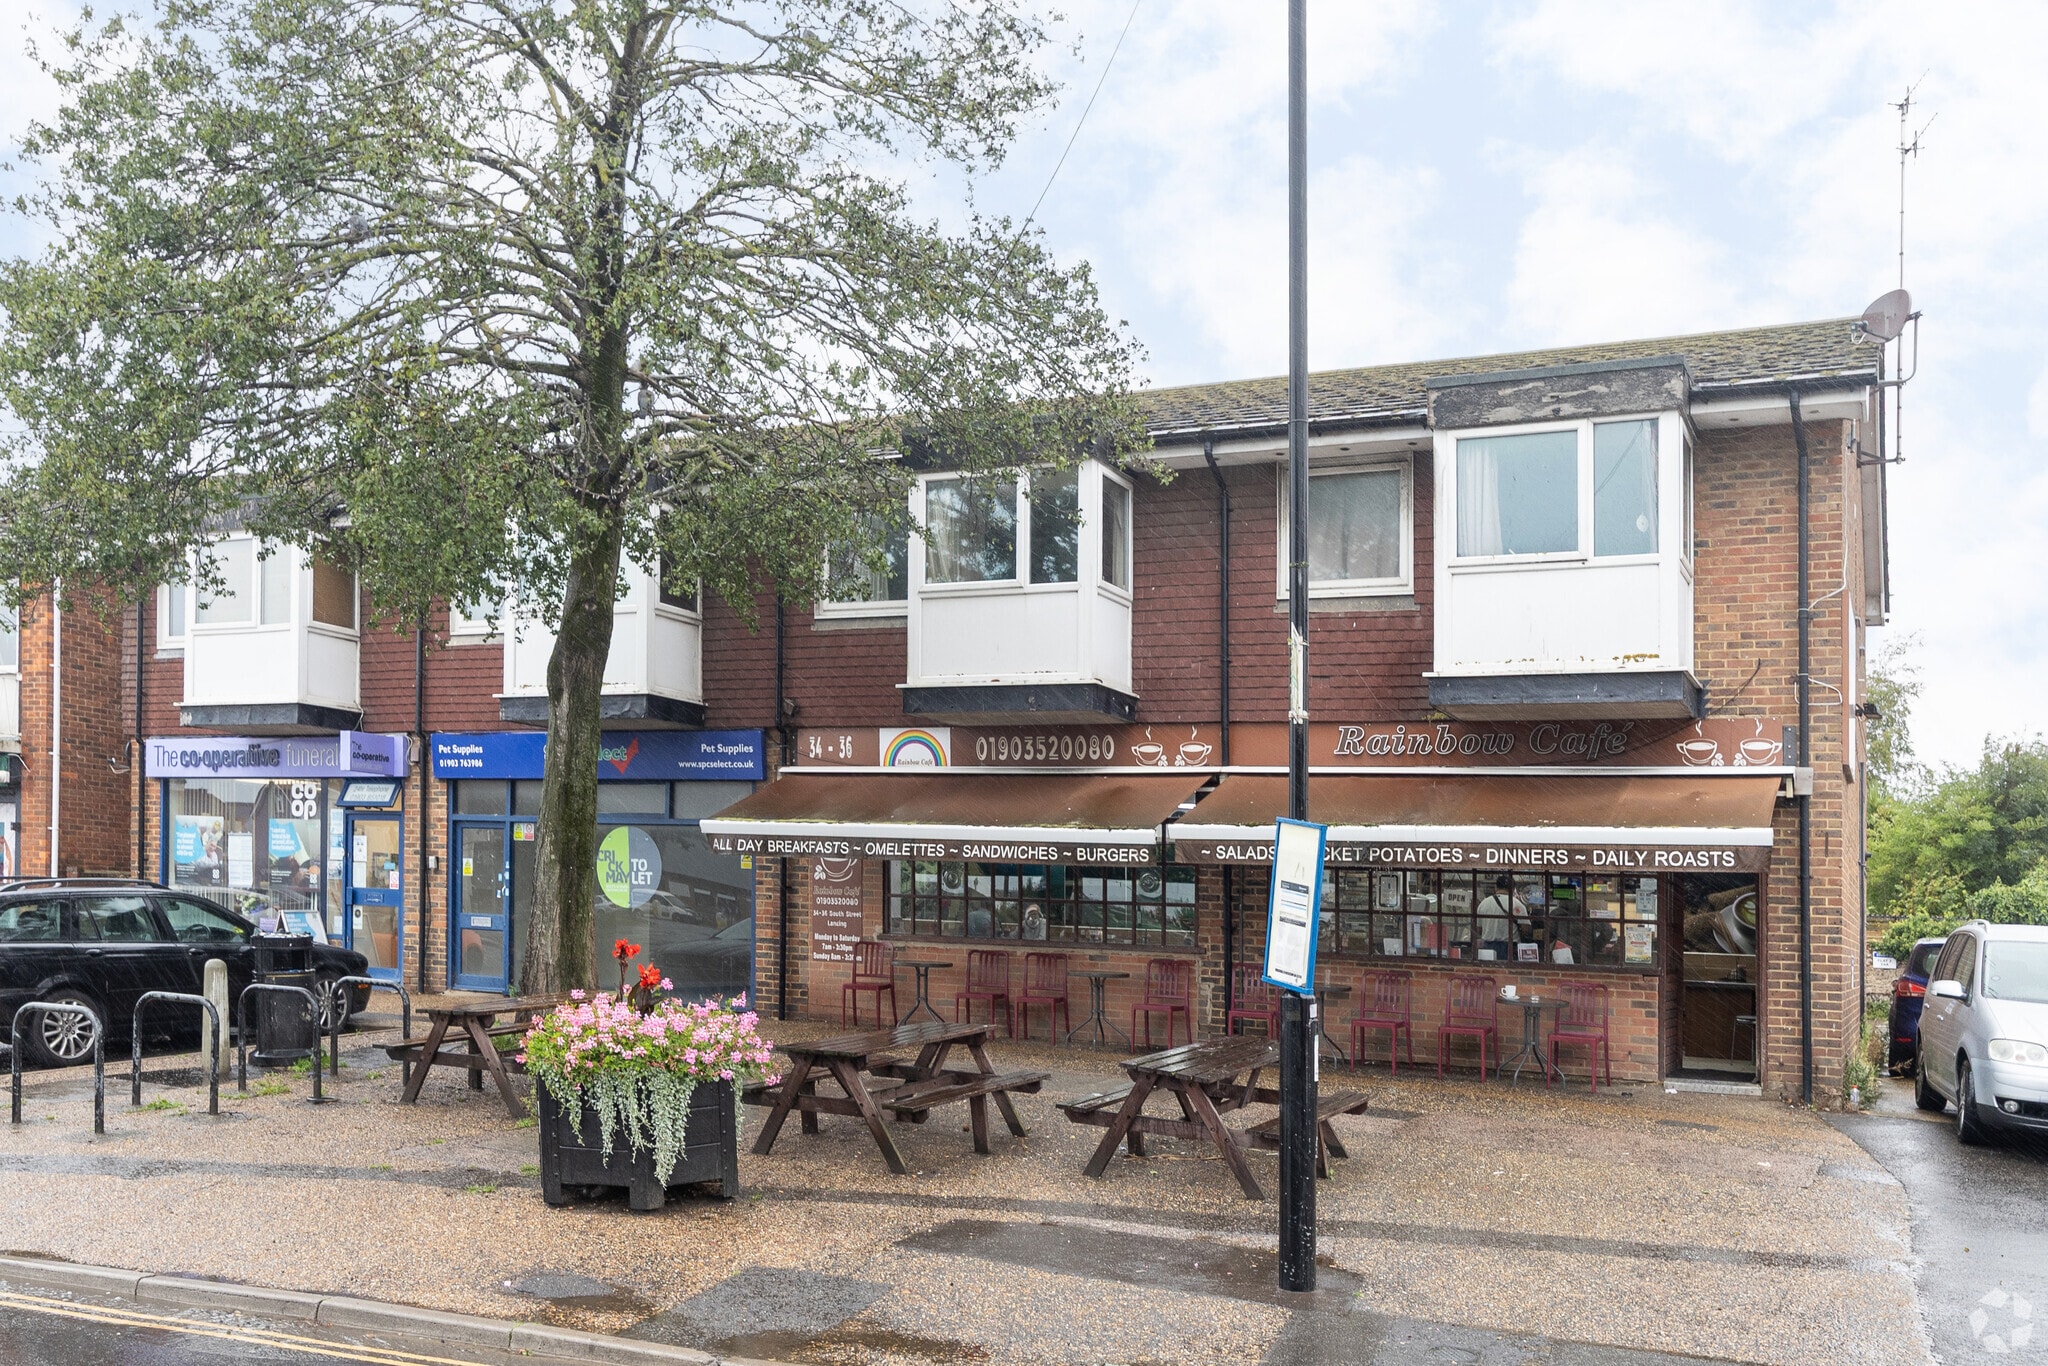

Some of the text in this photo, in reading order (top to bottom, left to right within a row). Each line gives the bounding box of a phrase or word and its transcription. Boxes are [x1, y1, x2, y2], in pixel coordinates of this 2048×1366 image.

[1334, 721, 1635, 760] Rainbow Café
[438, 744, 484, 756] Pet Supplies
[598, 744, 628, 761] lect
[701, 743, 754, 756] Pet Supplies
[809, 736, 822, 759] 34
[839, 735, 852, 759] 36
[976, 734, 1115, 761] 01903520080
[154, 745, 178, 767] The
[286, 743, 339, 767] funeral
[439, 759, 459, 768] 01903
[678, 759, 755, 769] www.spcselect.co.uk
[712, 838, 733, 851] ALL
[737, 838, 763, 852] DAY
[768, 840, 849, 855] BREAKFASTS
[865, 842, 945, 857] OMELETTES
[962, 844, 1058, 861] SANDWICHES
[1076, 847, 1150, 862] BURGERS
[1216, 844, 1276, 860] SALADS
[1324, 846, 1363, 862] CKET
[1369, 846, 1463, 863] POTATOES
[1486, 848, 1569, 865] DINNERS
[1593, 850, 1648, 867] DAILY
[1654, 850, 1735, 867] ROASTS
[631, 859, 647, 871] TO
[632, 872, 652, 884] LET
[816, 896, 859, 905] 01903520080
[1447, 893, 1466, 902] OPEN
[827, 920, 847, 928] Lancing
[814, 932, 832, 942] Monday
[839, 933, 860, 942] Saturday
[813, 951, 830, 961] Sunday
